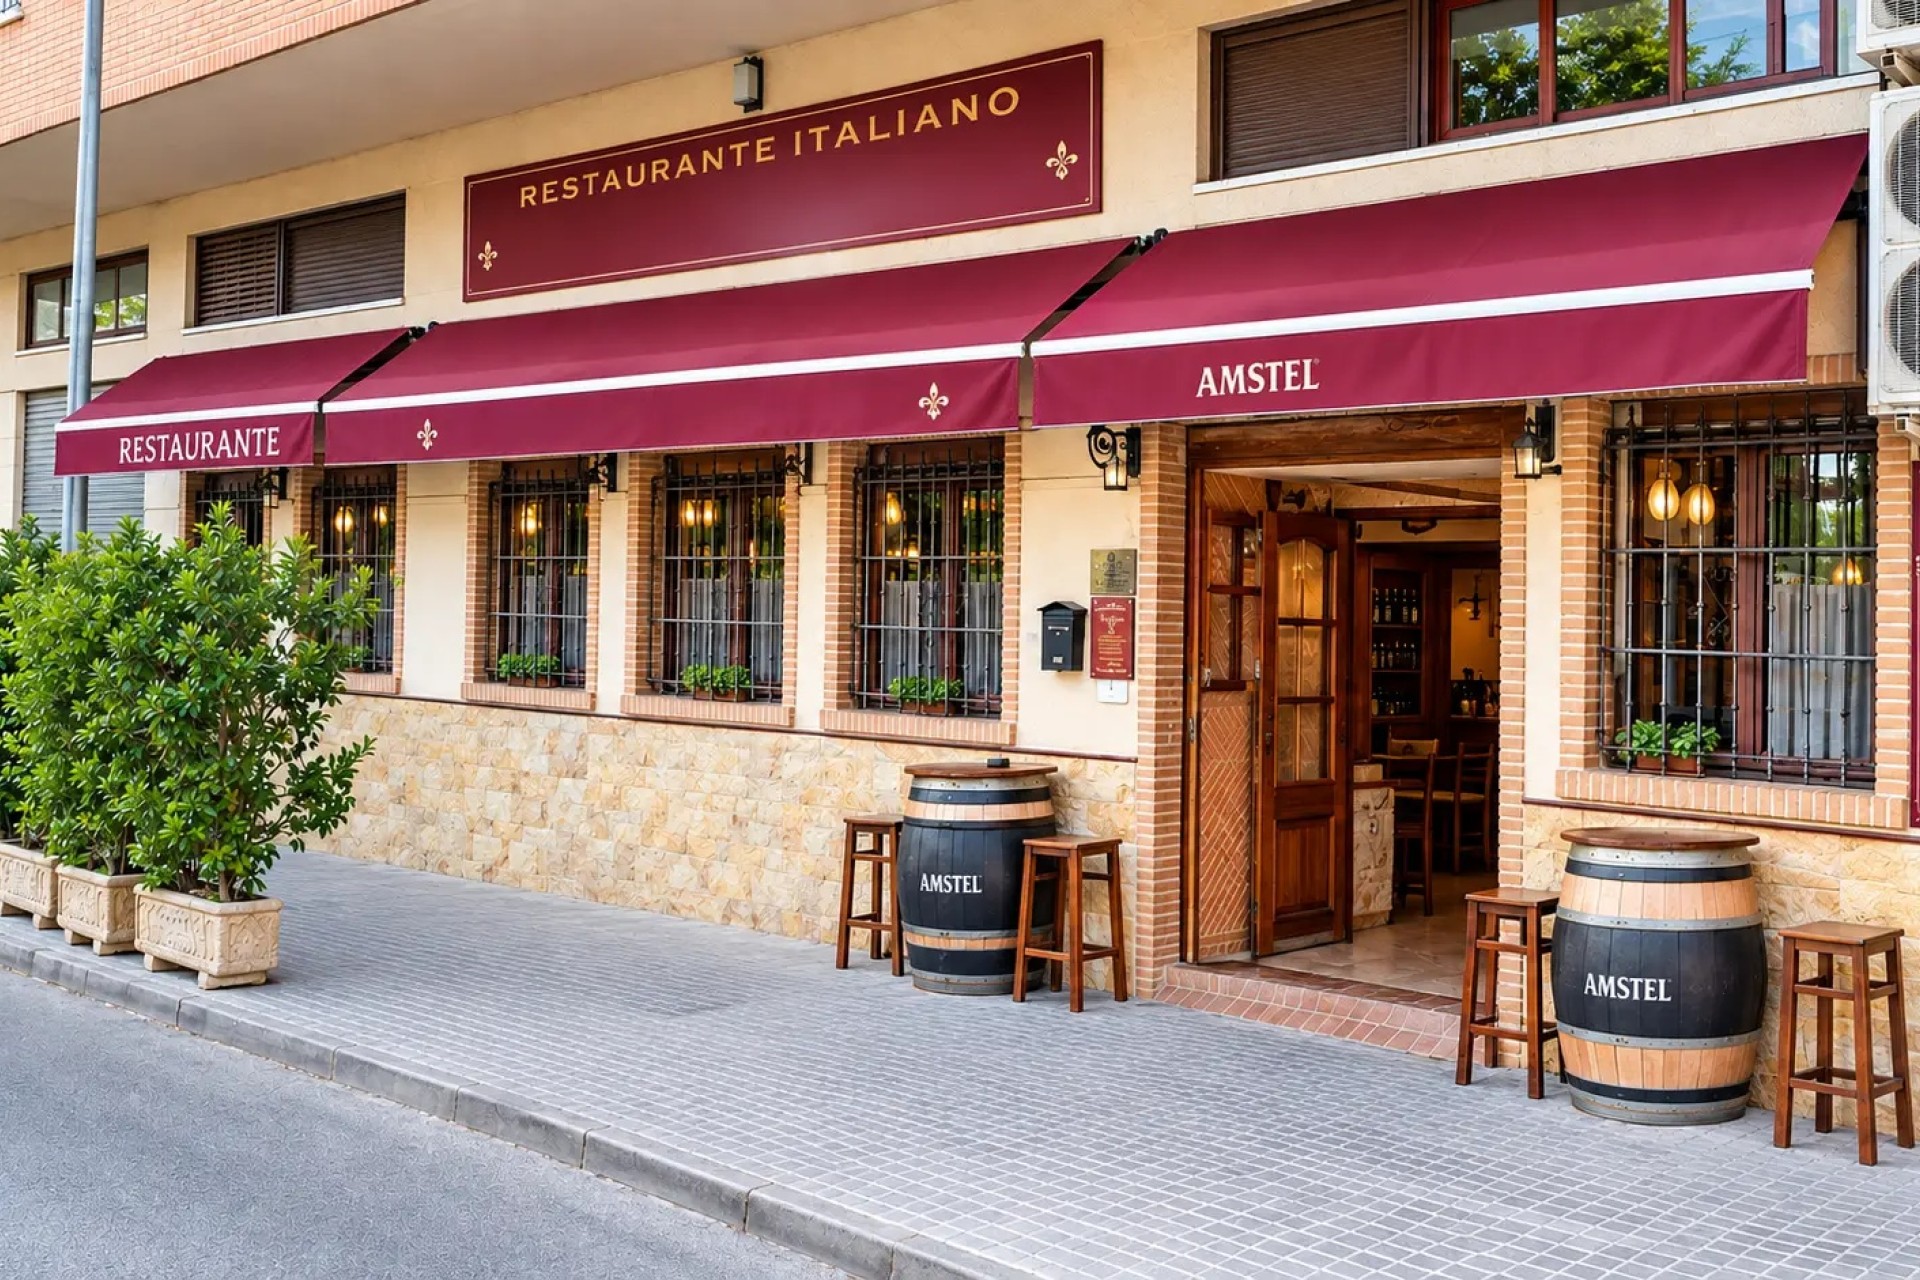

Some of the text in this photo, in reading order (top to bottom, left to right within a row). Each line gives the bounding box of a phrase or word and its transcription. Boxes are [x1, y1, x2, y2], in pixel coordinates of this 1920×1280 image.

[519, 85, 1020, 208] RESTAURANTE ITALIANO
[1196, 357, 1320, 398] AMSTEL
[119, 426, 281, 464] RESTAURANTE
[919, 872, 983, 894] AMSTEL
[1583, 972, 1672, 1003] AMSTEL
